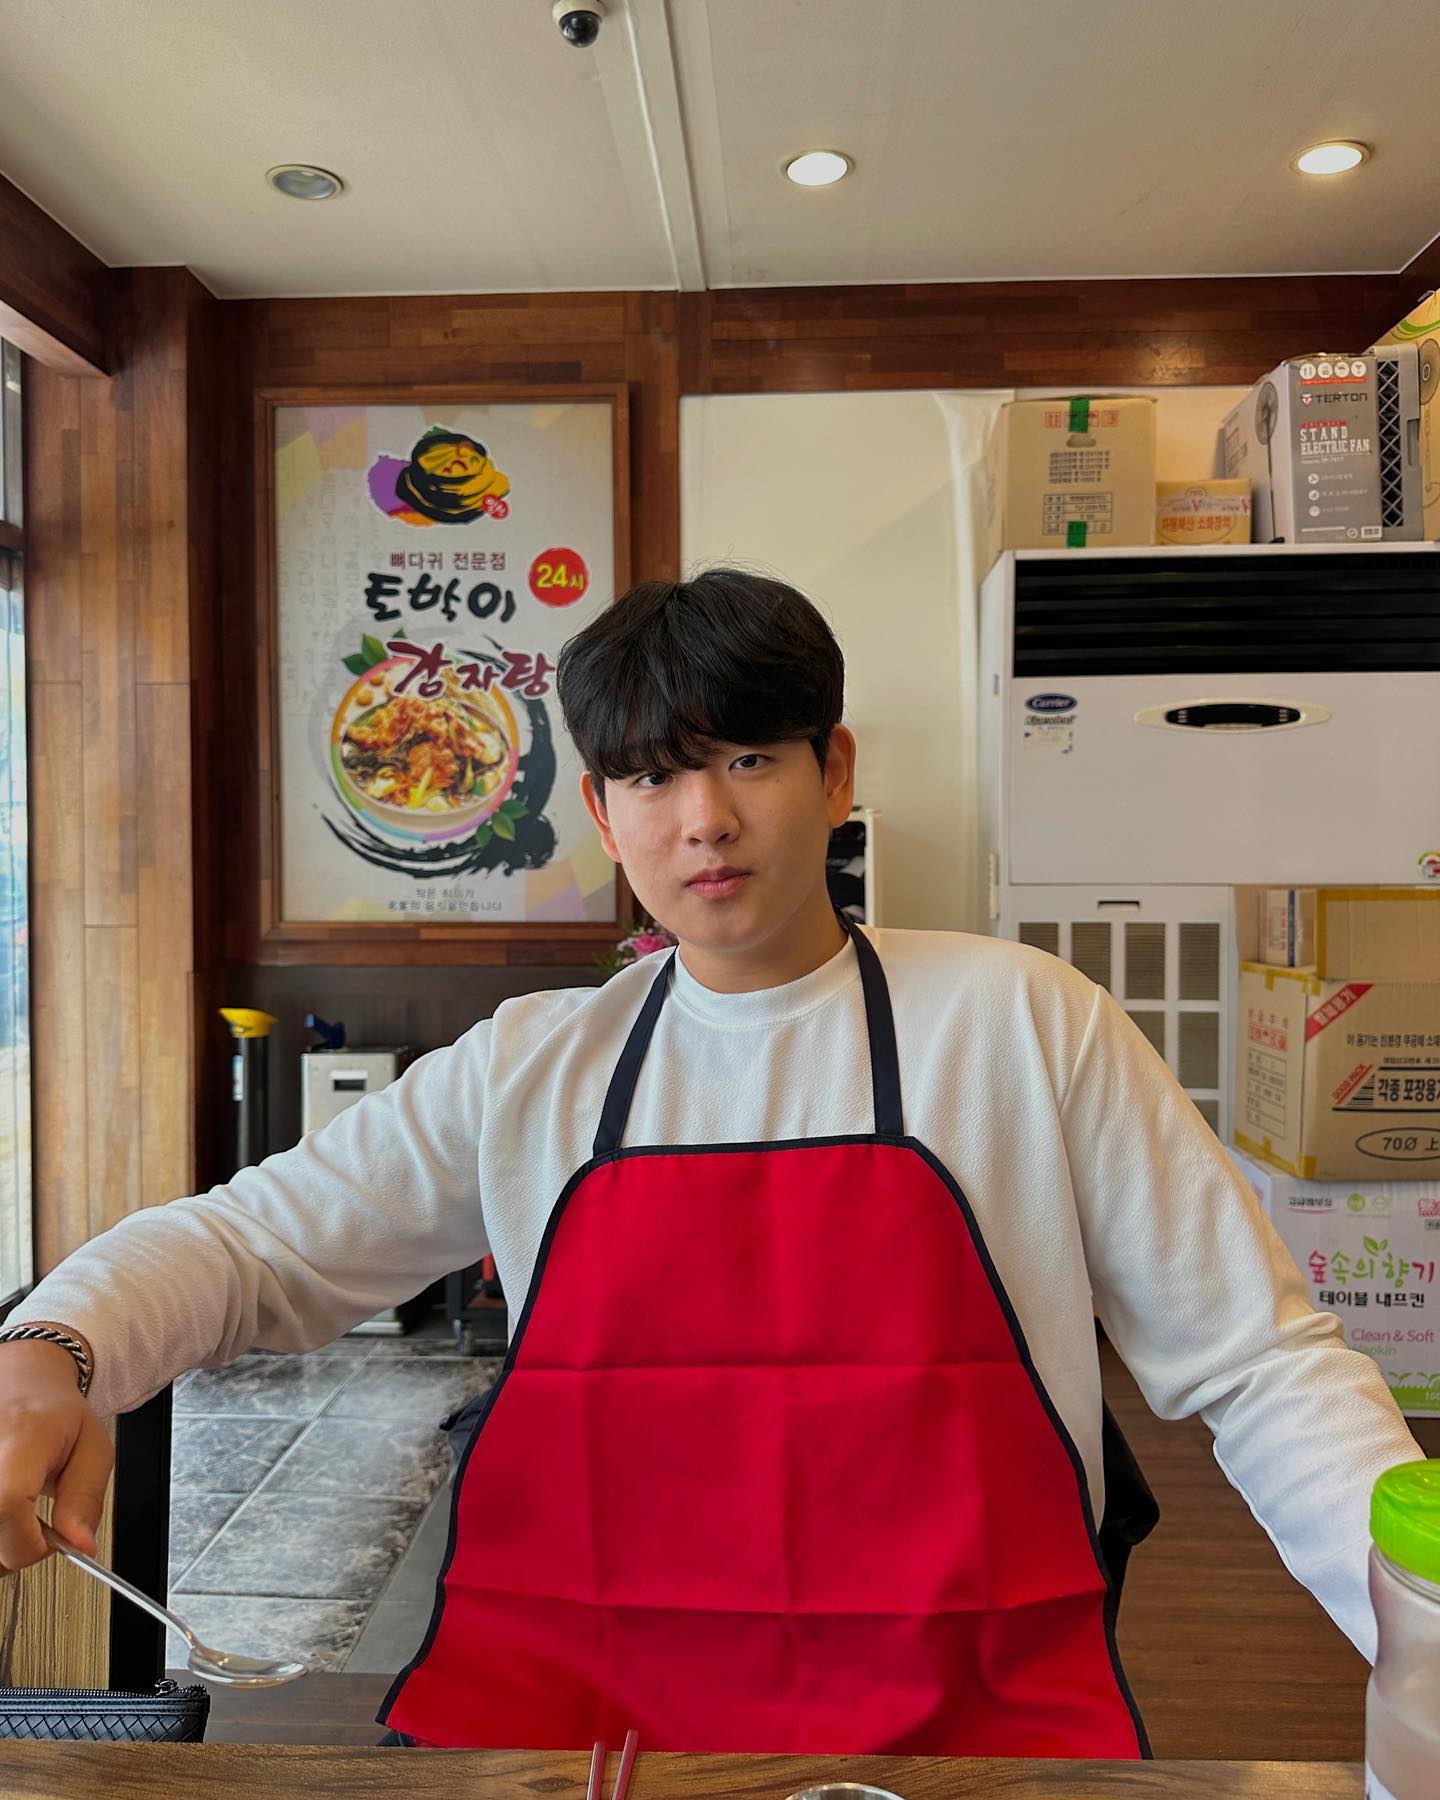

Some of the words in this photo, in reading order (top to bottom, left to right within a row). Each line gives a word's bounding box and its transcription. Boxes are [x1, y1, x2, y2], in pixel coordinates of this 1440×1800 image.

[1300, 426, 1348, 441] STAND
[1301, 440, 1347, 455] ELECTRIC
[1350, 439, 1370, 452] FAN
[453, 552, 506, 570] 전문점
[365, 573, 517, 622] 토박이
[387, 641, 556, 697] 감자탕
[1378, 1079, 1400, 1101] 각종
[1309, 1250, 1374, 1285] 숲속의
[1382, 1251, 1435, 1288] 향기
[1319, 1291, 1368, 1306] 테이블
[1351, 1328, 1390, 1342] Clean
[1393, 1330, 1403, 1342] &
[1407, 1330, 1434, 1342] Soft
